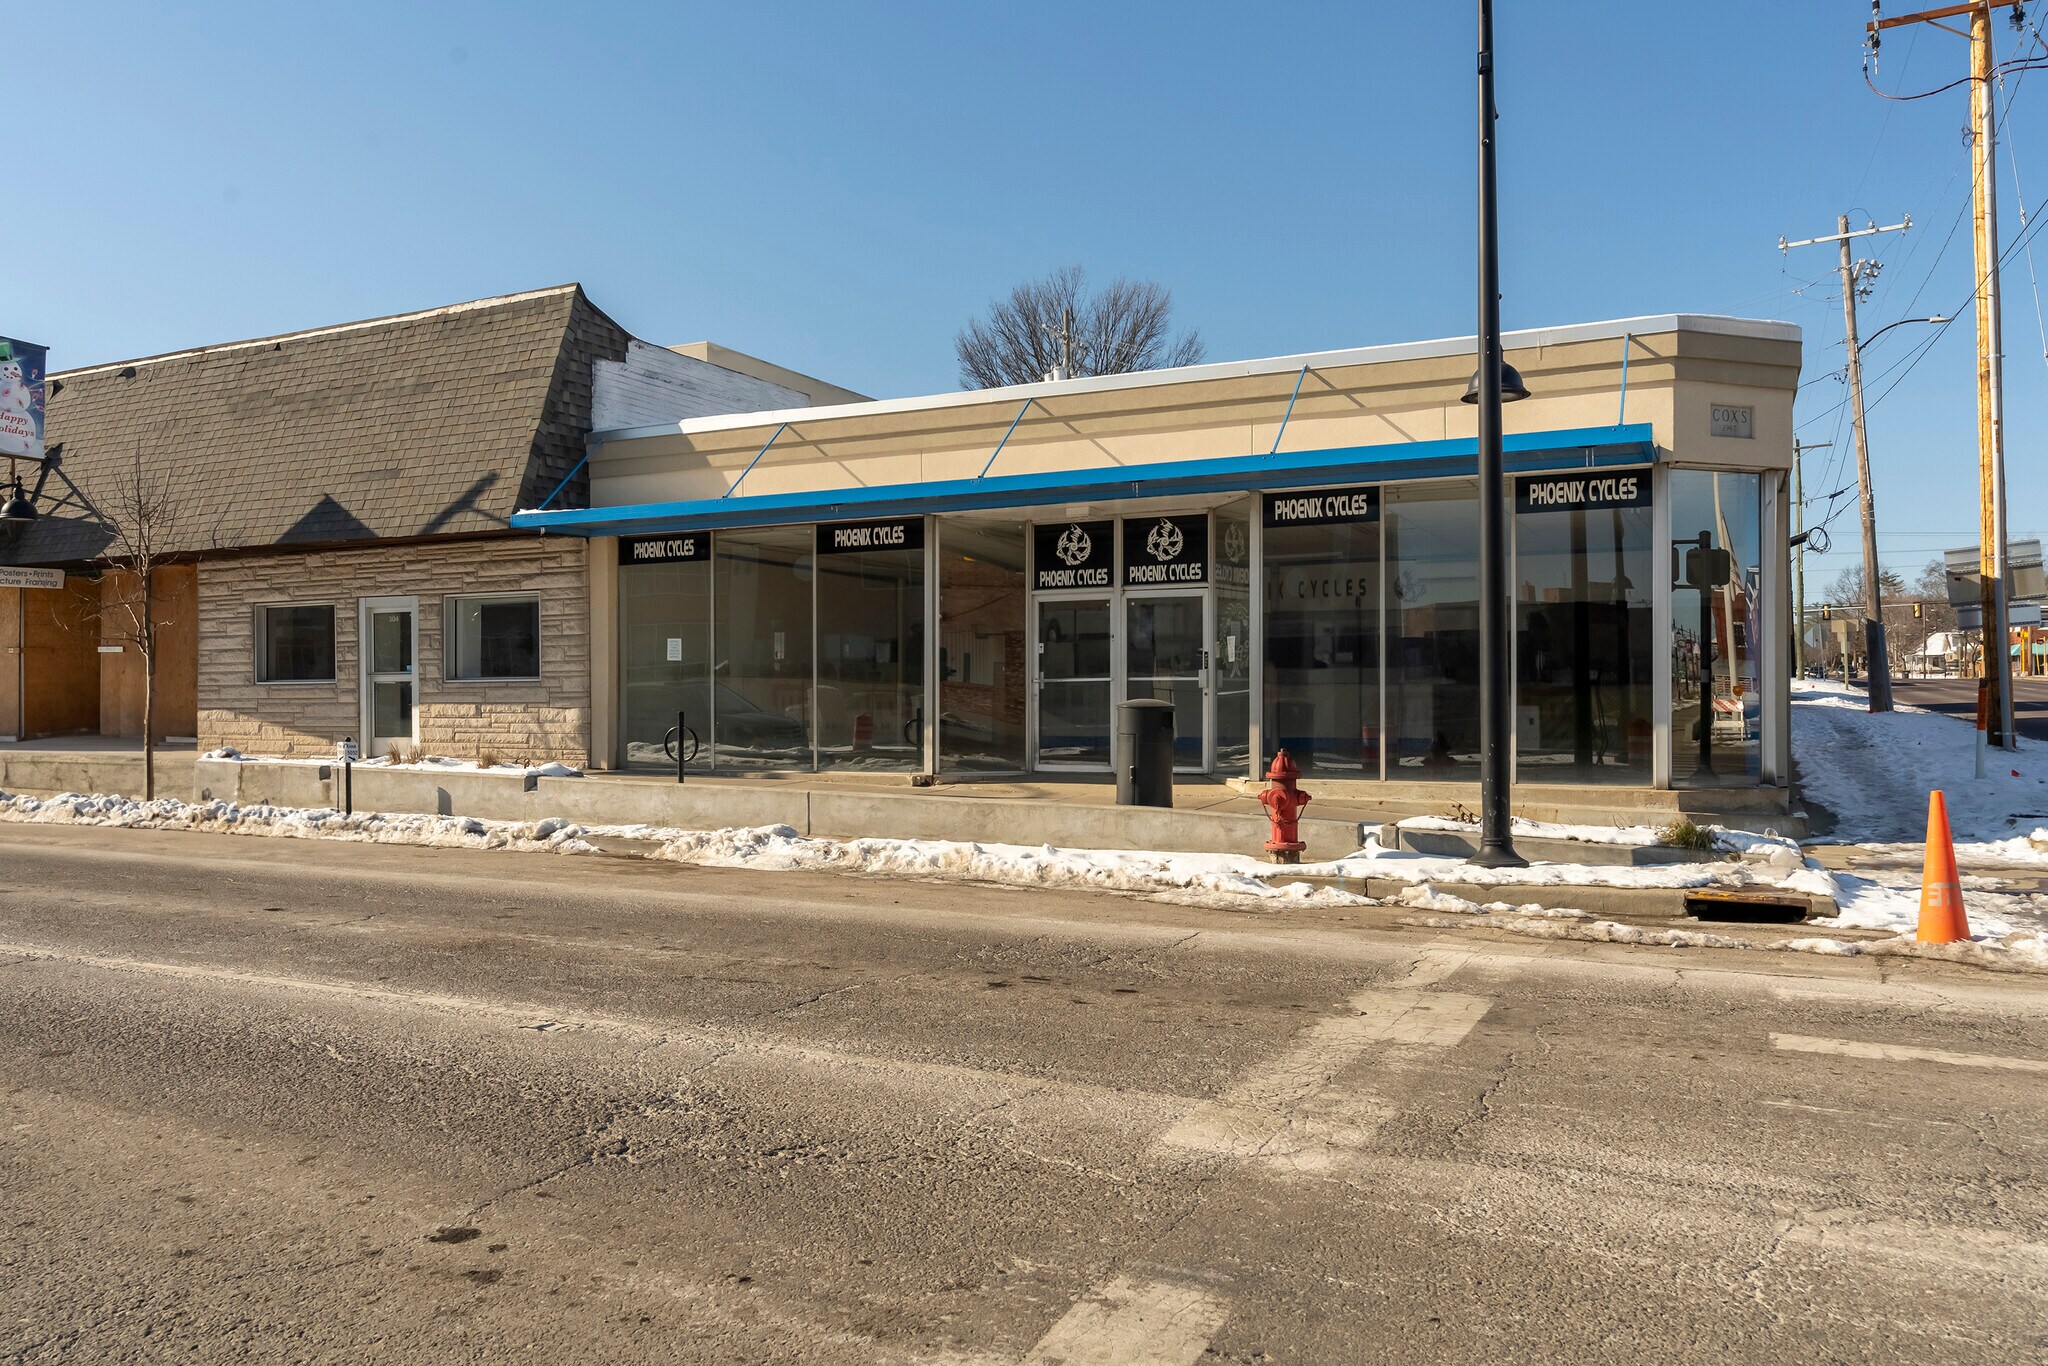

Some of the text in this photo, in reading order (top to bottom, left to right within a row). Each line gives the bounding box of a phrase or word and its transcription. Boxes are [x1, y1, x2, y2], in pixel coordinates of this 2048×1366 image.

[1529, 477, 1638, 505] PHOENIX CYCLES
[1274, 494, 1367, 520] PHOENIX CYCLES
[834, 525, 905, 548] PHOENIX CYCLES
[633, 539, 695, 559] PHOENIX CYCLES
[25, 578, 58, 588] Framing
[33, 570, 54, 579] Prints
[1039, 567, 1108, 587] PHOENIX CYCLES
[1129, 562, 1202, 583] PHOENIX CYCLES
[1298, 578, 1367, 599] CYCLES
